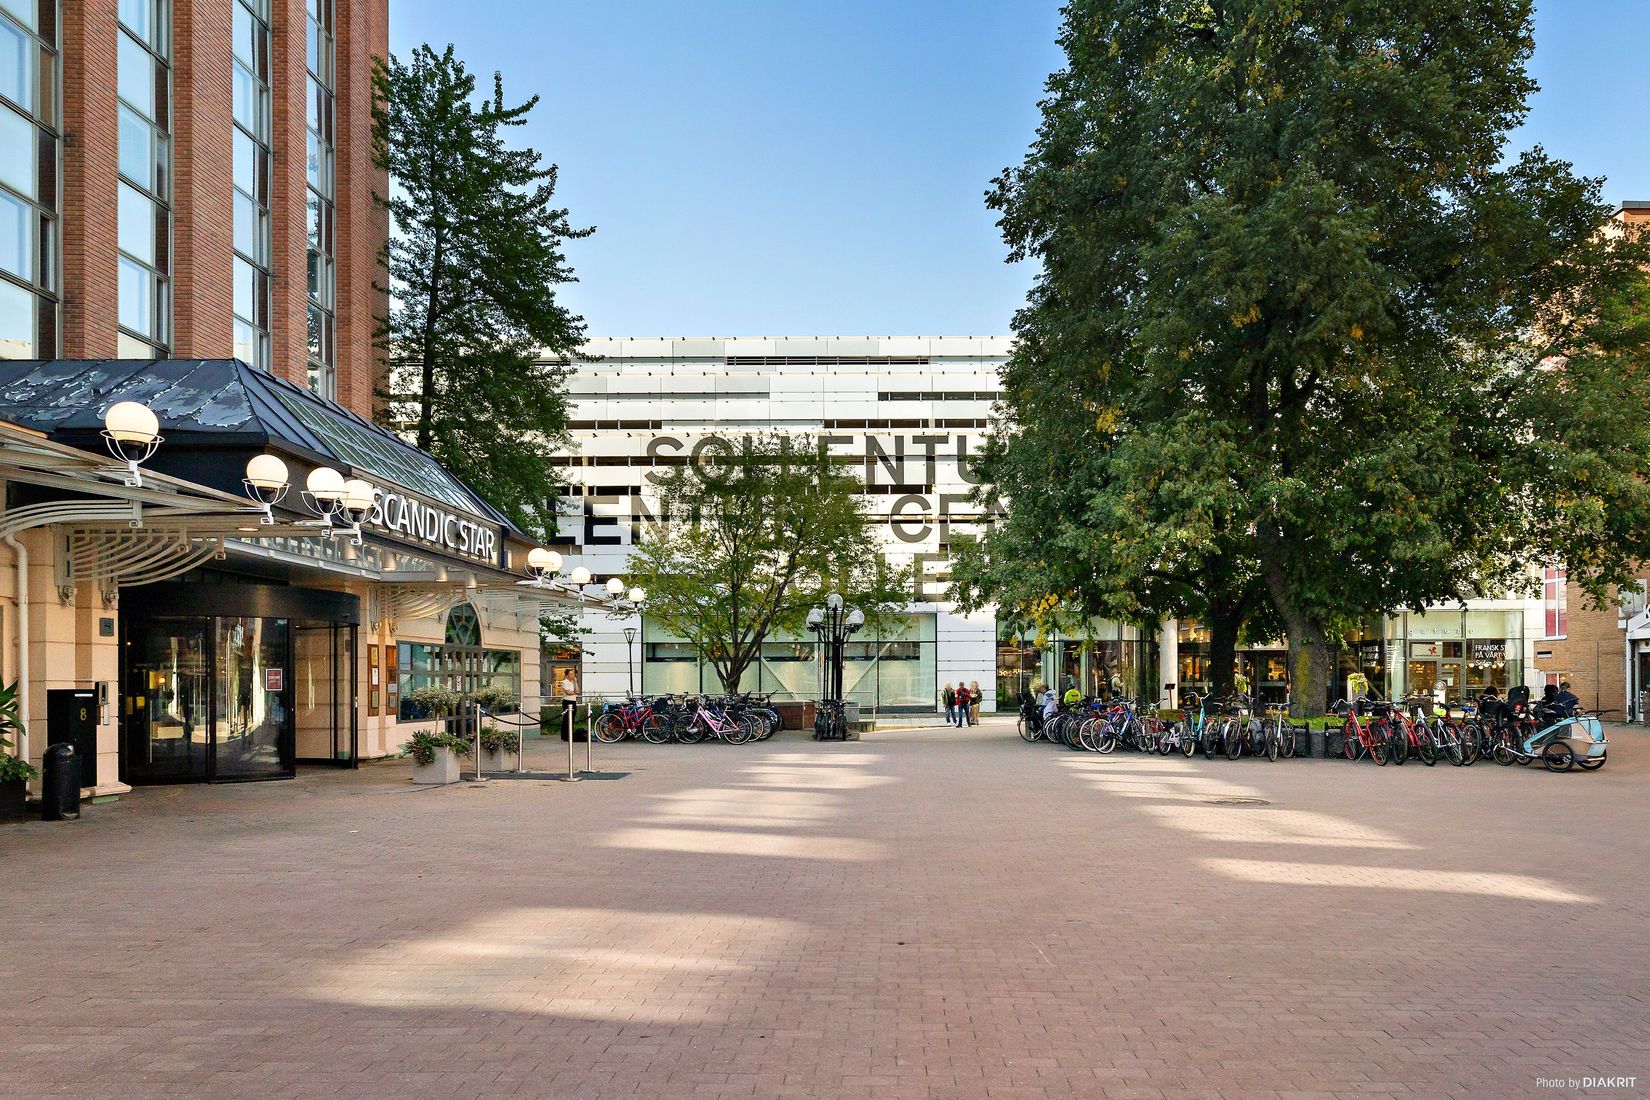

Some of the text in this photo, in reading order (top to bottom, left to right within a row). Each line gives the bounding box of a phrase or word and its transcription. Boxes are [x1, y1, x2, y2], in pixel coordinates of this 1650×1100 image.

[371, 488, 495, 559] SCANDIC STAR
[1475, 650, 1484, 659] PÅ
[80, 708, 87, 720] 8
